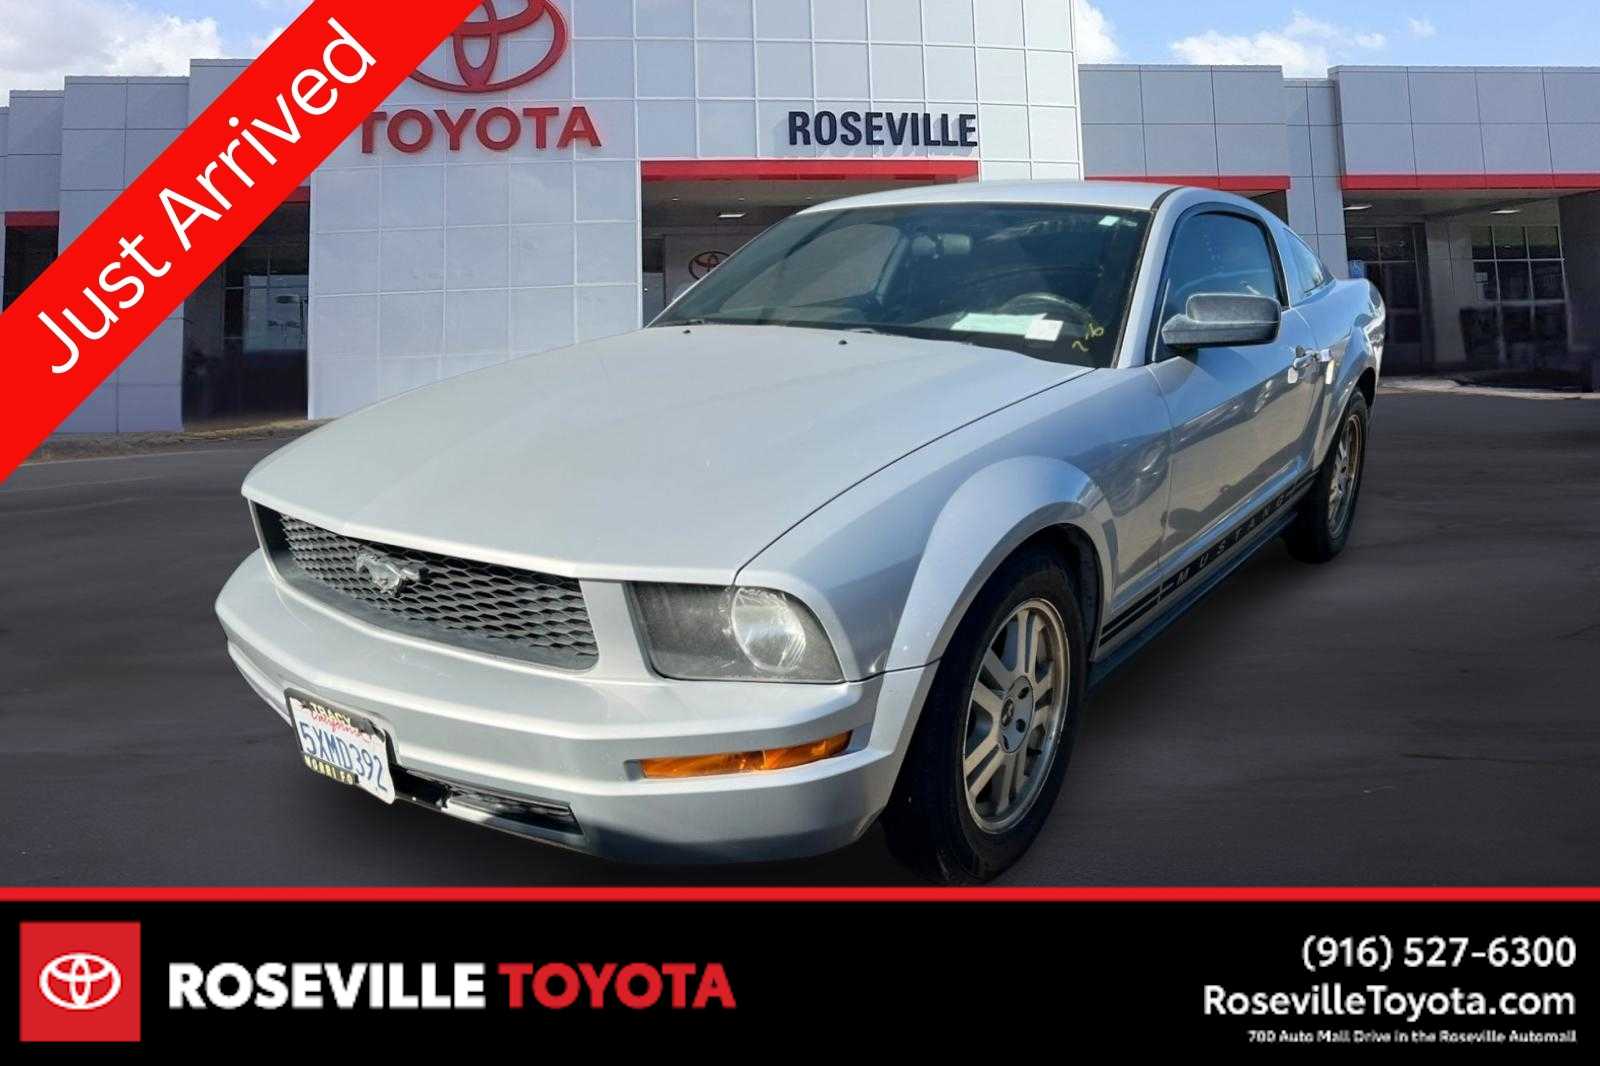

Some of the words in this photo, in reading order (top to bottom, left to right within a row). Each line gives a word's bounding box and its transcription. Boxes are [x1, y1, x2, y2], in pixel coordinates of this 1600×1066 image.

[361, 106, 602, 154] TOYOTA
[788, 111, 978, 147] ROSEVILLE
[300, 721, 388, 792] 5XMD392
